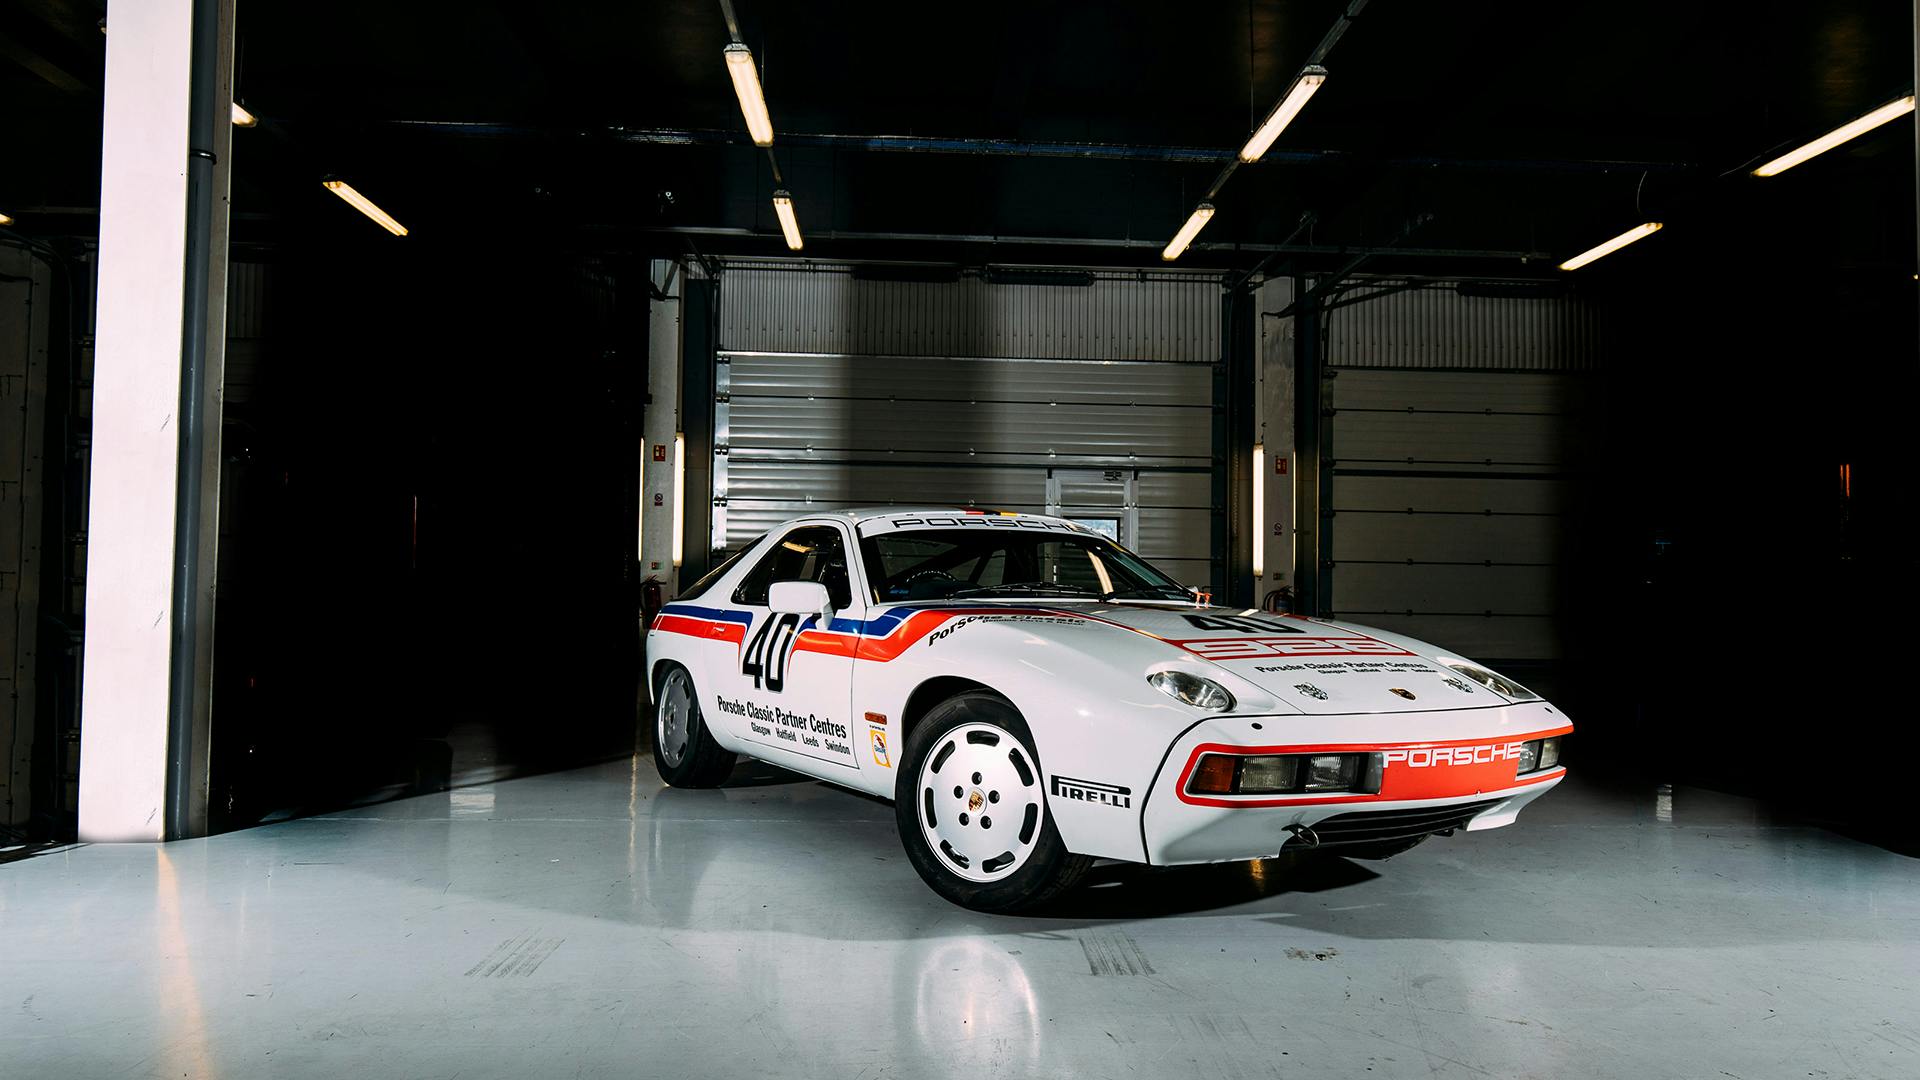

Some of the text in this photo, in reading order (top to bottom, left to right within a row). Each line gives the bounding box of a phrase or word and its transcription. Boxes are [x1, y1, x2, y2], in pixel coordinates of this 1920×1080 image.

[928, 615, 1002, 646] Porsche
[1181, 614, 1307, 634] 40
[742, 612, 800, 693] 40
[1181, 639, 1408, 658] 928
[1254, 664, 1305, 673] Porsche
[717, 695, 847, 739] Porsche Classic Partner Centres
[751, 722, 850, 755] Glasgow Hatfield Leeds Swindon
[1382, 742, 1522, 768] PORSCHE
[1051, 775, 1131, 808] PIRELLI
